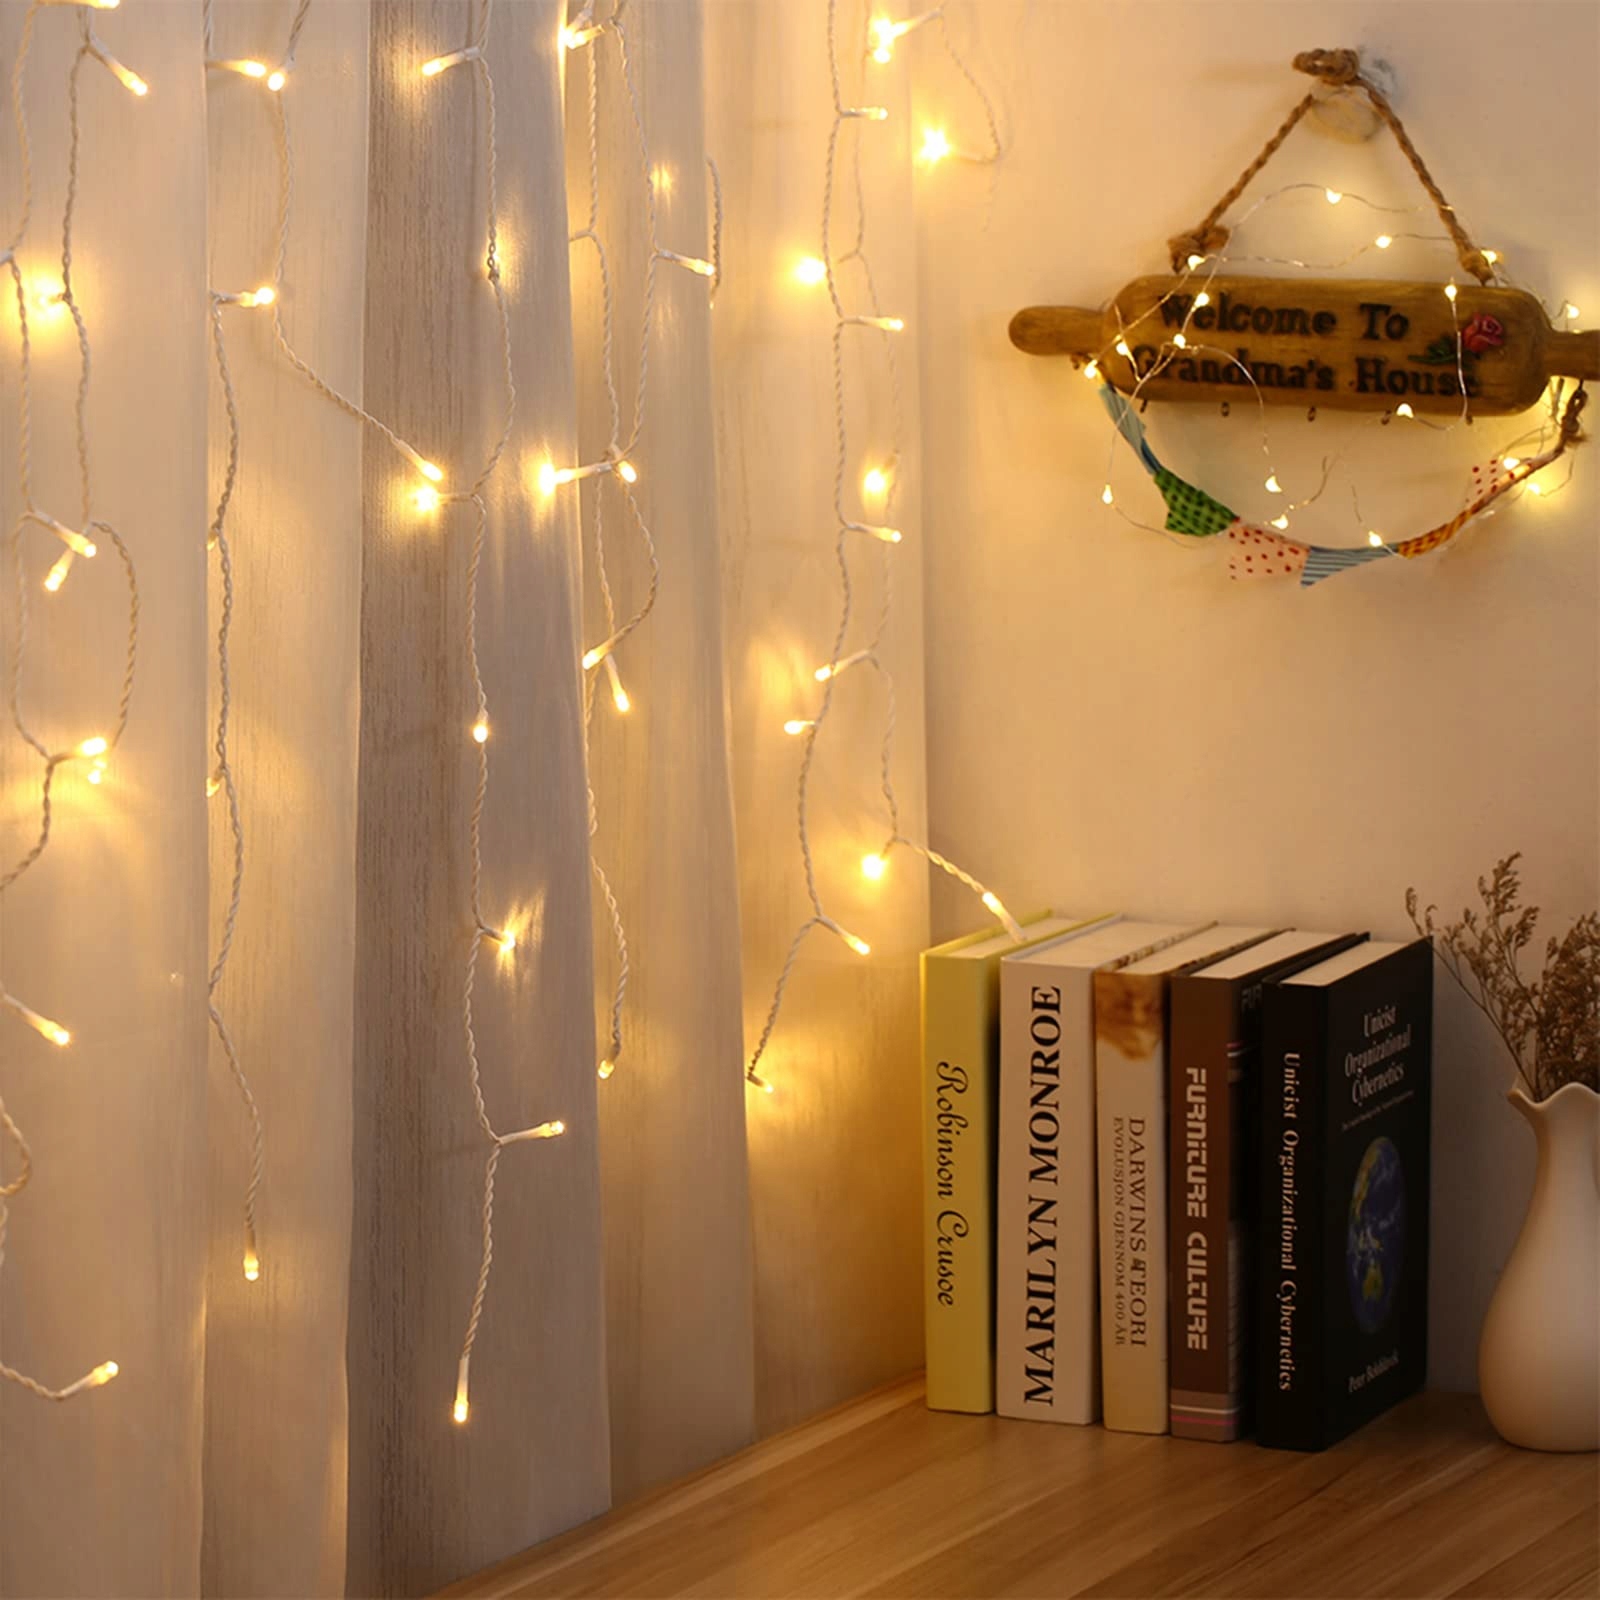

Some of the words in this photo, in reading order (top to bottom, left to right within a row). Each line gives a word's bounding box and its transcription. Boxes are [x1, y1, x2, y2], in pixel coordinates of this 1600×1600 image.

[1158, 293, 1337, 335] Welcome
[1360, 303, 1410, 341] To
[1132, 345, 1335, 391] Grandma's
[1355, 356, 1483, 399] House
[936, 1061, 969, 1200] Robinson
[1028, 985, 1062, 1185] MONROE
[1283, 1052, 1300, 1119] Unicist
[1112, 1117, 1125, 1207] EVOLUSJON
[1129, 1117, 1147, 1252] DARWINS
[1279, 1130, 1299, 1270] Organizational
[936, 1210, 970, 1307] Crusoe
[1024, 1195, 1058, 1407] MARILYN
[1112, 1211, 1126, 1287] GJENNOM
[1187, 1231, 1208, 1350] CULTURE
[1115, 1292, 1127, 1321] 400
[1276, 1280, 1297, 1392] Cybernetics
